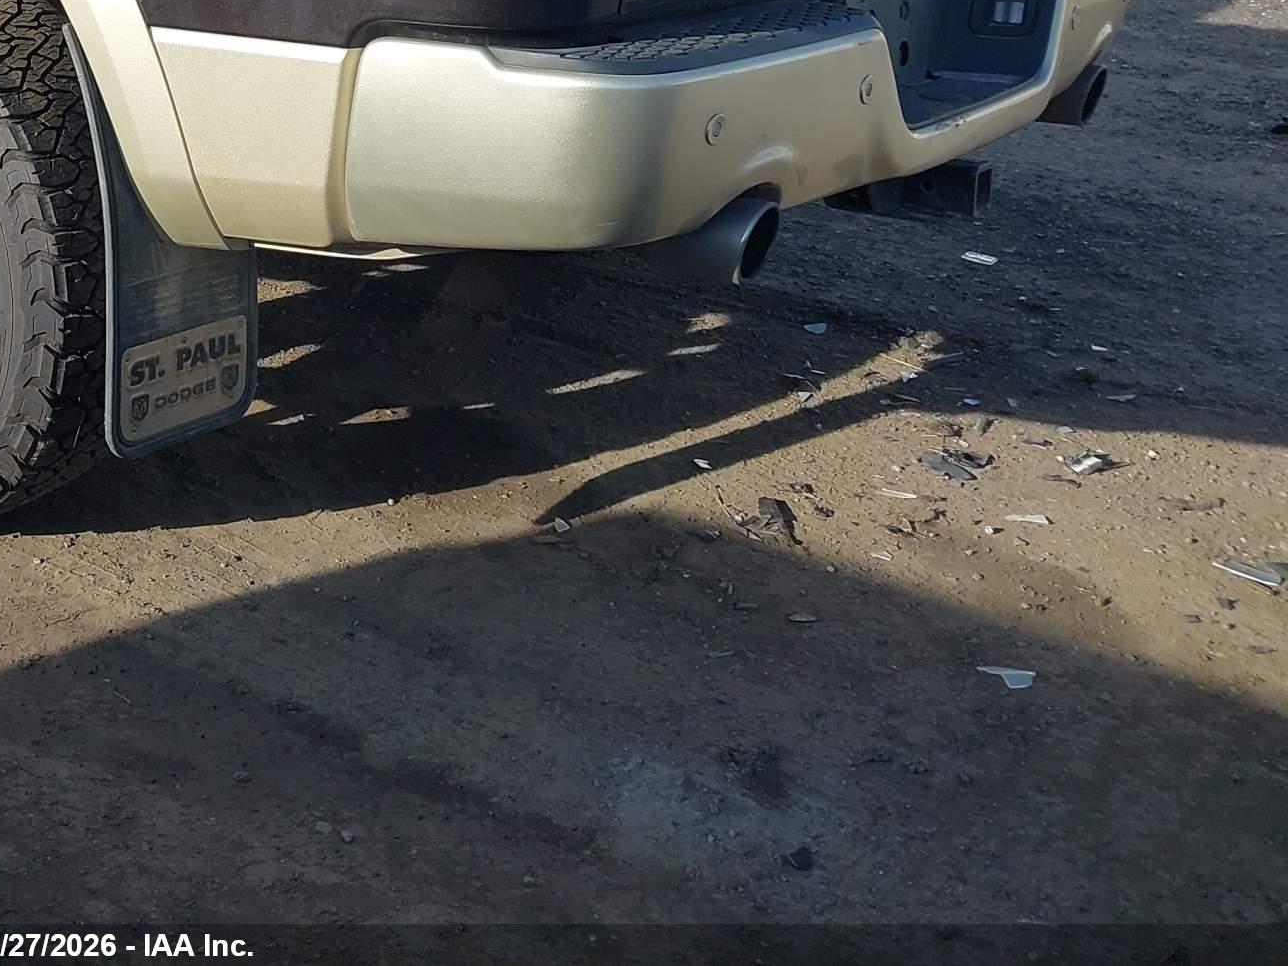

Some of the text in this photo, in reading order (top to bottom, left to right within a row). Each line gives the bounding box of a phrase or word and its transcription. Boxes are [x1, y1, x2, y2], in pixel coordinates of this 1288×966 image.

[129, 333, 241, 387] ST. PAUL
[154, 378, 217, 410] DODGE
